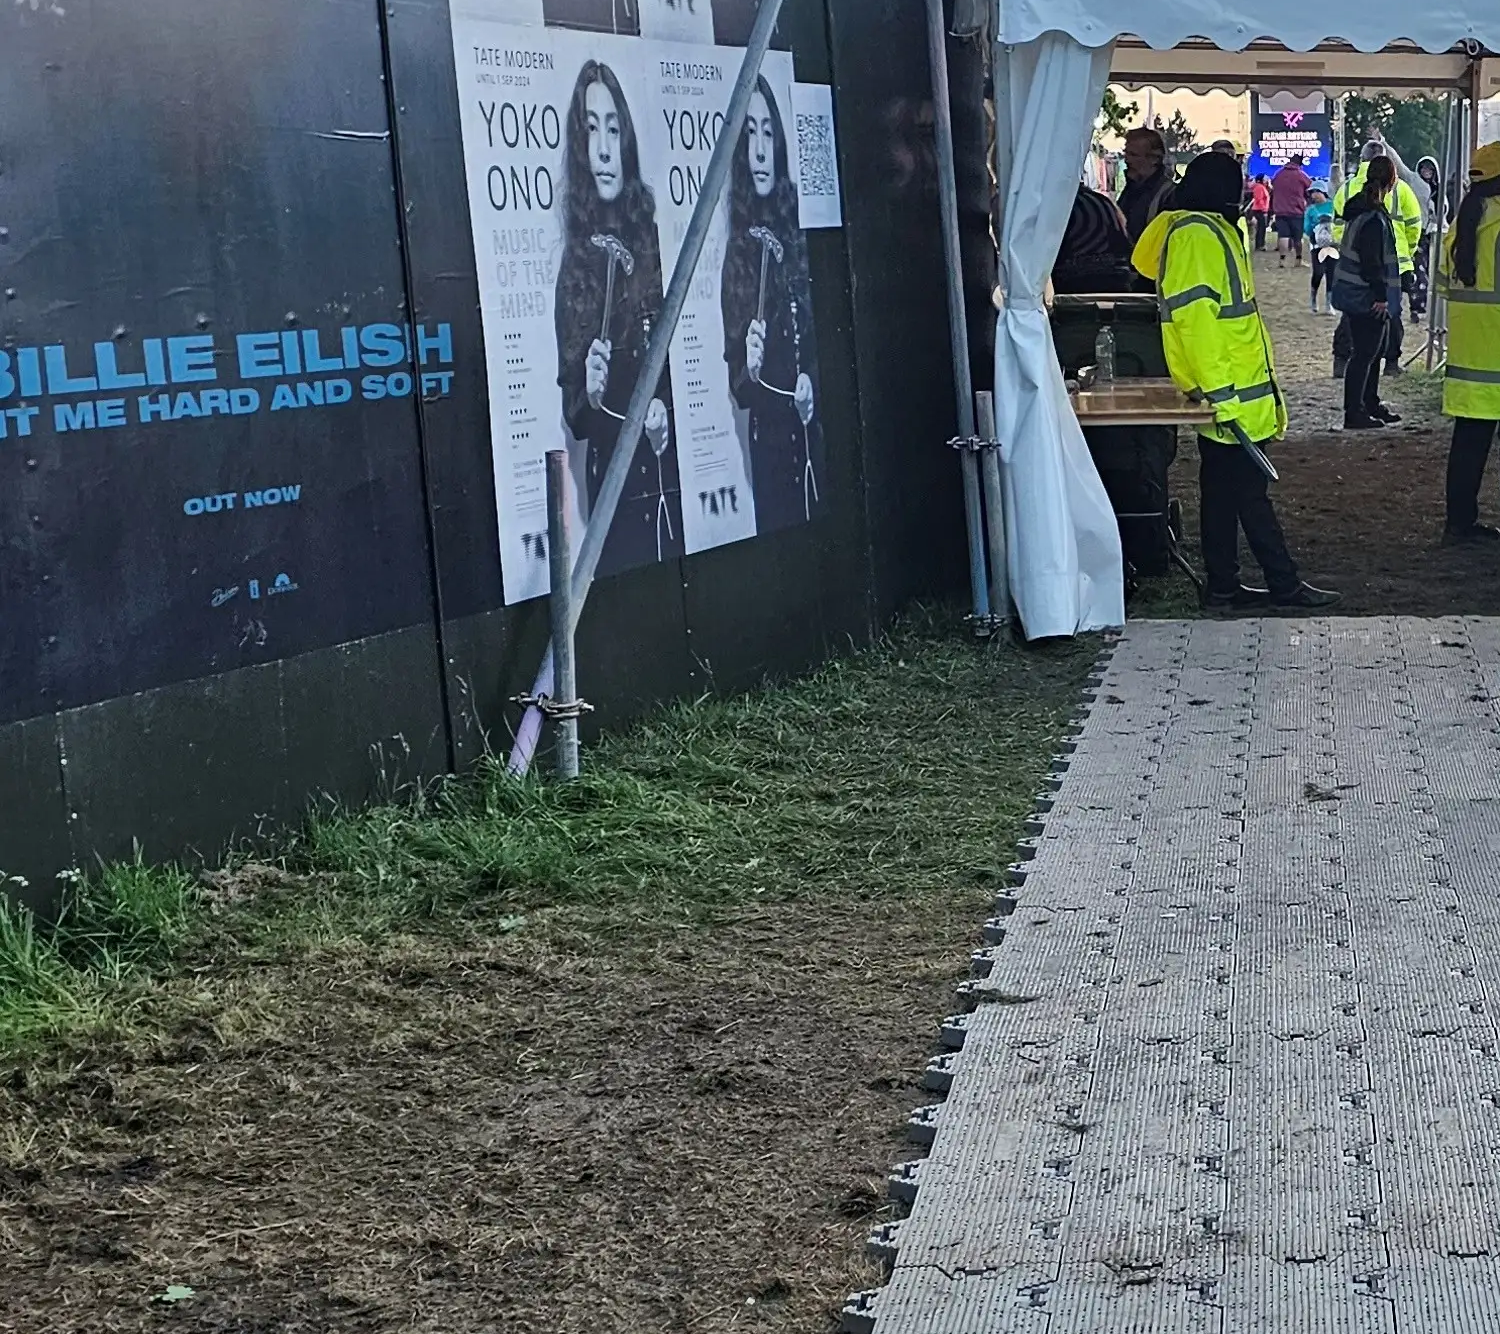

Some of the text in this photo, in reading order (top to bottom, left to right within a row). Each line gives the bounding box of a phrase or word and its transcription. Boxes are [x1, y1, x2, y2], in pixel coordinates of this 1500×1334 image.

[473, 47, 554, 70] TATE MODERN
[660, 61, 723, 82] TATE MODERN
[475, 73, 496, 84] UNTIL
[478, 100, 560, 149] YOKO
[488, 165, 553, 210] ONO
[668, 165, 702, 206] ON
[493, 228, 546, 255] MUSIC
[497, 259, 554, 287] OF THE
[501, 291, 547, 319] MIND
[236, 322, 454, 379] EILISH
[53, 398, 127, 432] ME
[138, 387, 261, 423] HARD
[270, 378, 352, 411] AND
[361, 371, 455, 400] SOFT
[183, 484, 302, 516] OUT NOW
[699, 484, 739, 518] TATE
